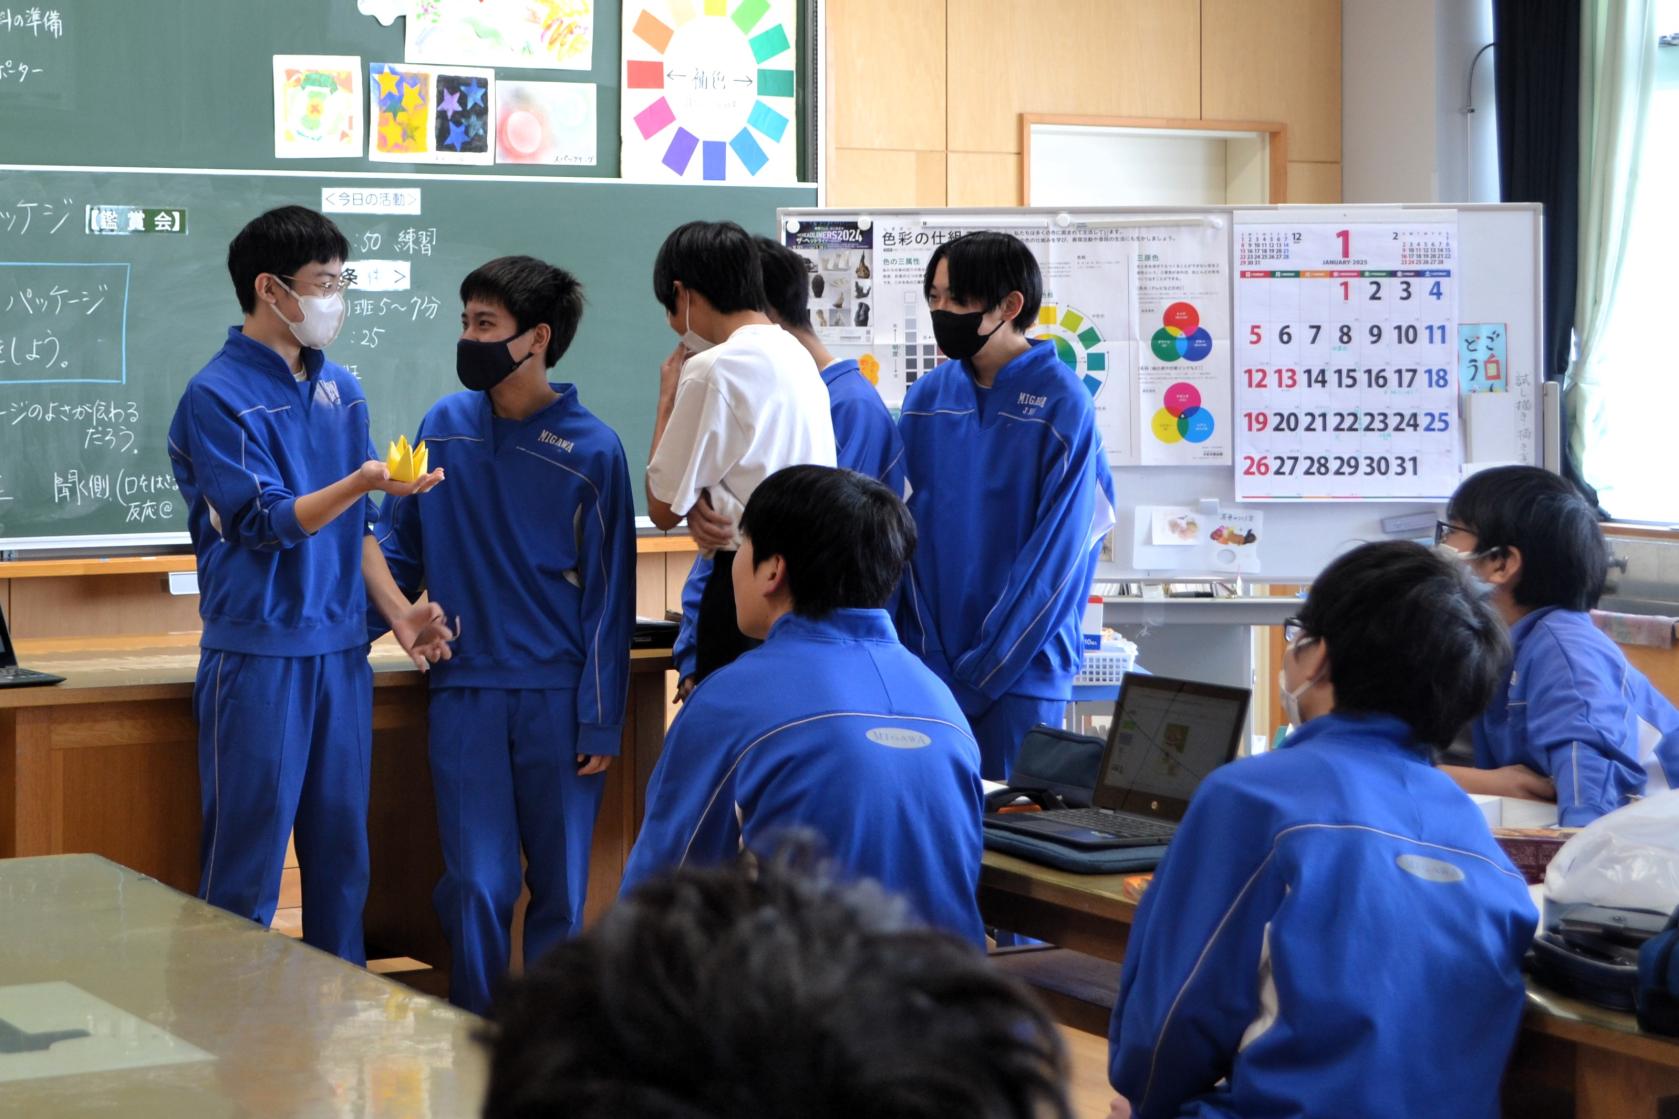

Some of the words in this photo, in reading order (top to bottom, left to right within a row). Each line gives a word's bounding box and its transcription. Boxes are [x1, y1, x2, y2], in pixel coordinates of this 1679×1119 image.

[393, 227, 437, 256] 練習
[882, 230, 966, 247] 色彩の仕組
[1292, 232, 1302, 241] 12
[1335, 229, 1351, 259] 1
[1392, 232, 1399, 241] 2
[6, 284, 108, 315] パッケージ
[1339, 281, 1349, 301] 1
[1369, 280, 1382, 301] 2
[1399, 280, 1412, 301] 3
[1428, 280, 1443, 301] 4
[1249, 324, 1262, 345] 5
[1278, 324, 1292, 345] 6
[1308, 324, 1322, 345] 7
[1338, 324, 1352, 345] 8
[1368, 324, 1383, 345] 9
[1393, 324, 1418, 345] 10
[1425, 324, 1446, 345] 11
[1244, 368, 1268, 388] 12
[1274, 368, 1297, 389] 13
[1303, 368, 1328, 388] 14
[1333, 368, 1358, 389] 15
[1363, 368, 1388, 389] 16
[1394, 368, 1418, 388] 17
[1424, 368, 1449, 389] 18
[1243, 412, 1268, 432] 19
[1272, 412, 1299, 432] 20
[1303, 411, 1327, 432] 21
[1332, 411, 1359, 432] 22
[1362, 412, 1389, 432] 23
[1392, 412, 1420, 432] 24
[1423, 412, 1450, 433] 25
[1243, 455, 1270, 476] 26
[1273, 455, 1299, 476] 27
[1303, 455, 1330, 476] 28
[1333, 455, 1360, 476] 29
[1363, 455, 1390, 476] 30
[1394, 456, 1418, 476] 31
